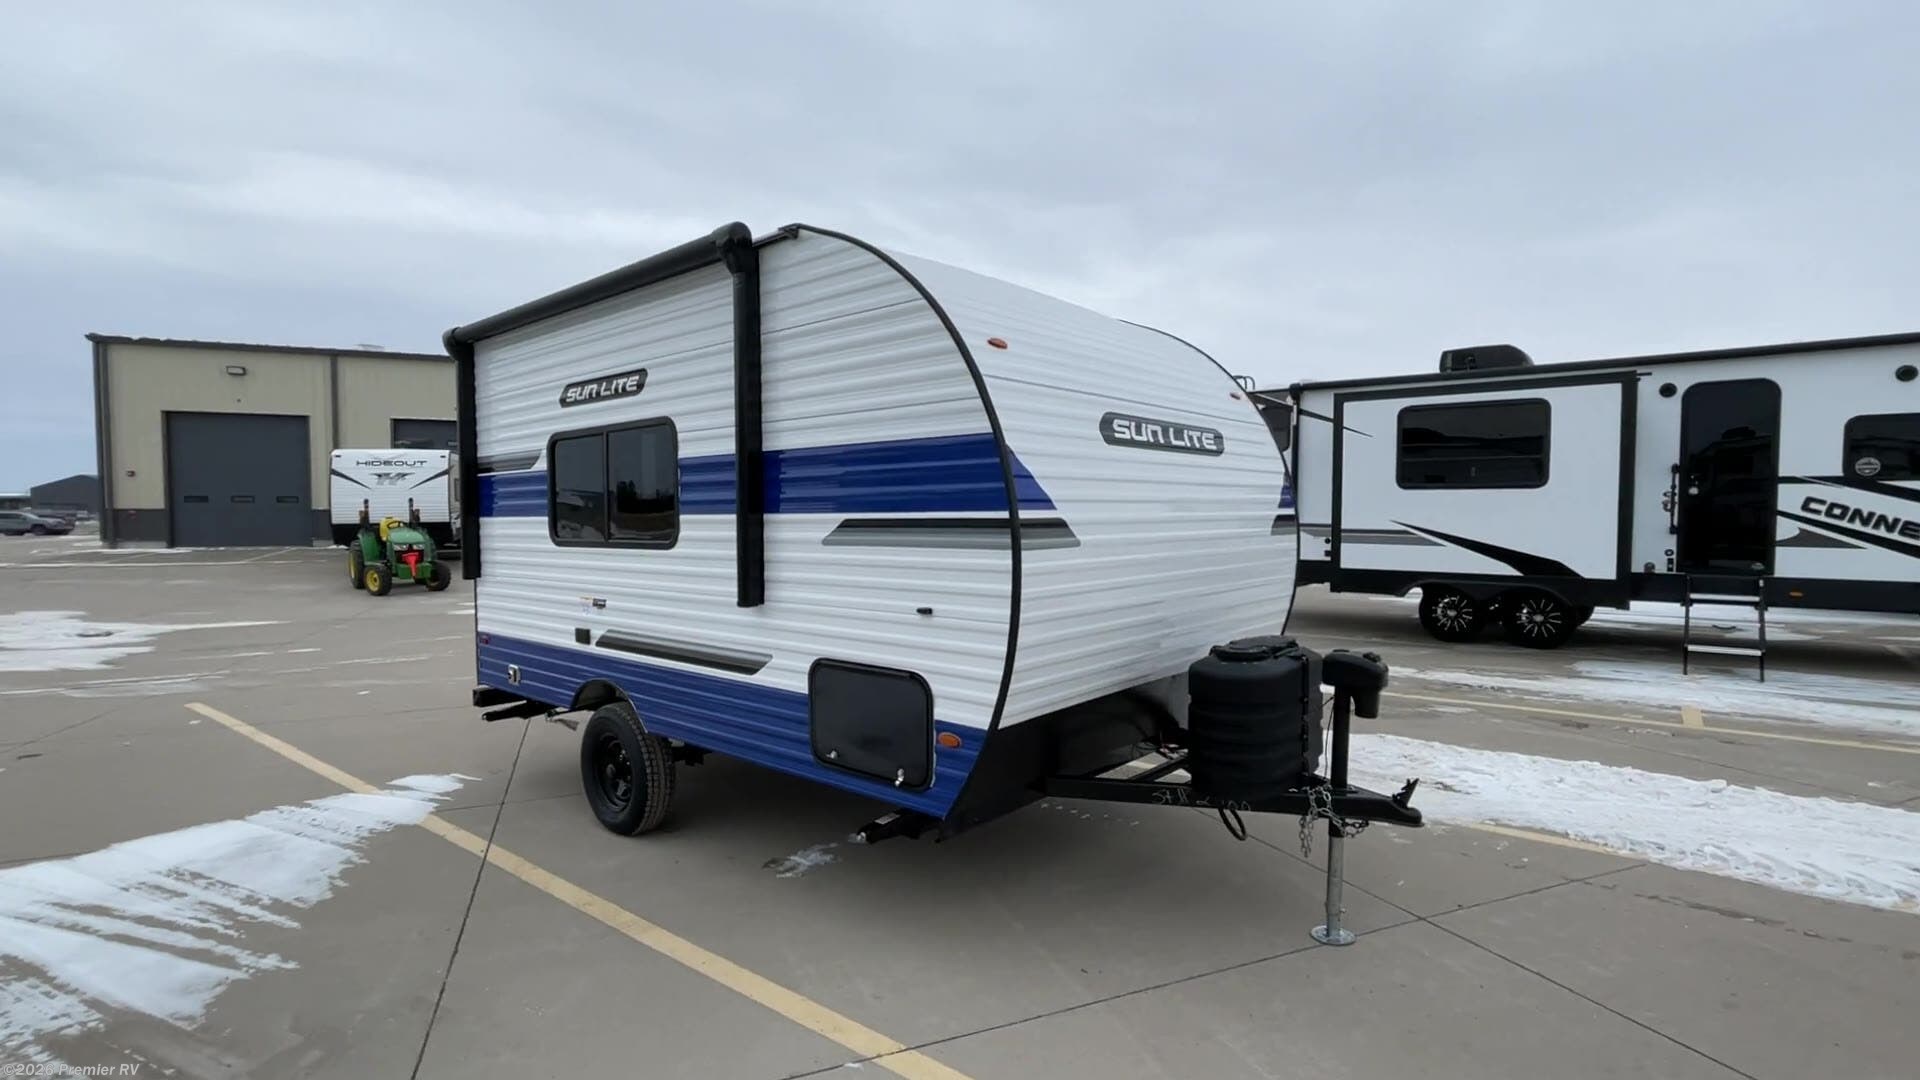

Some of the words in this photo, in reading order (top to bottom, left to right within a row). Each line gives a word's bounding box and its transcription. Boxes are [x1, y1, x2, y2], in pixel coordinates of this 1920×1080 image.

[600, 375, 640, 396] LITE
[1112, 419, 1165, 444] SUN
[1168, 427, 1218, 450] LITE
